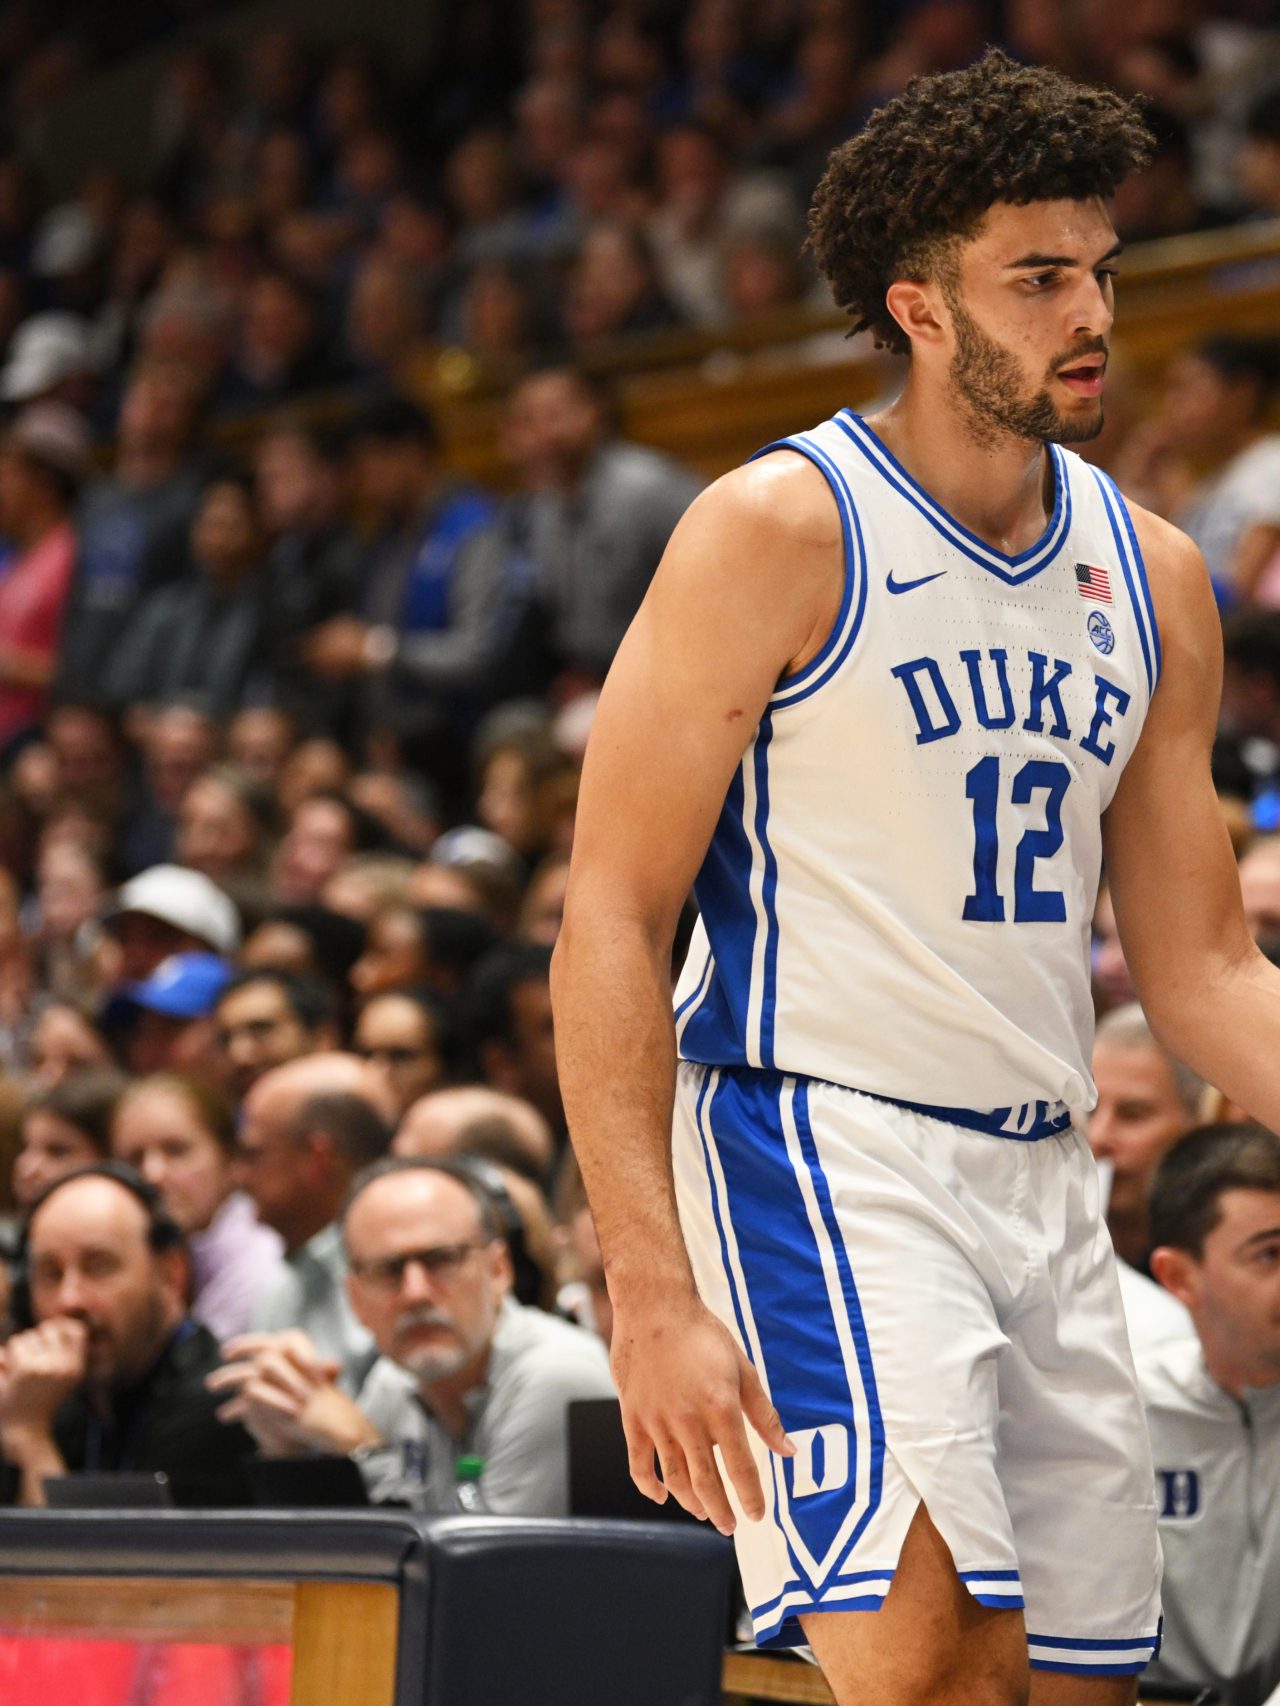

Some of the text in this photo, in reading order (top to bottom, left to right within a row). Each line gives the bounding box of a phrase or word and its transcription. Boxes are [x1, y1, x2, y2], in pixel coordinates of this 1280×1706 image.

[1091, 624, 1112, 638] ACC
[890, 649, 1131, 766] DUKE
[962, 756, 1072, 922] 12
[785, 1423, 849, 1498] D
